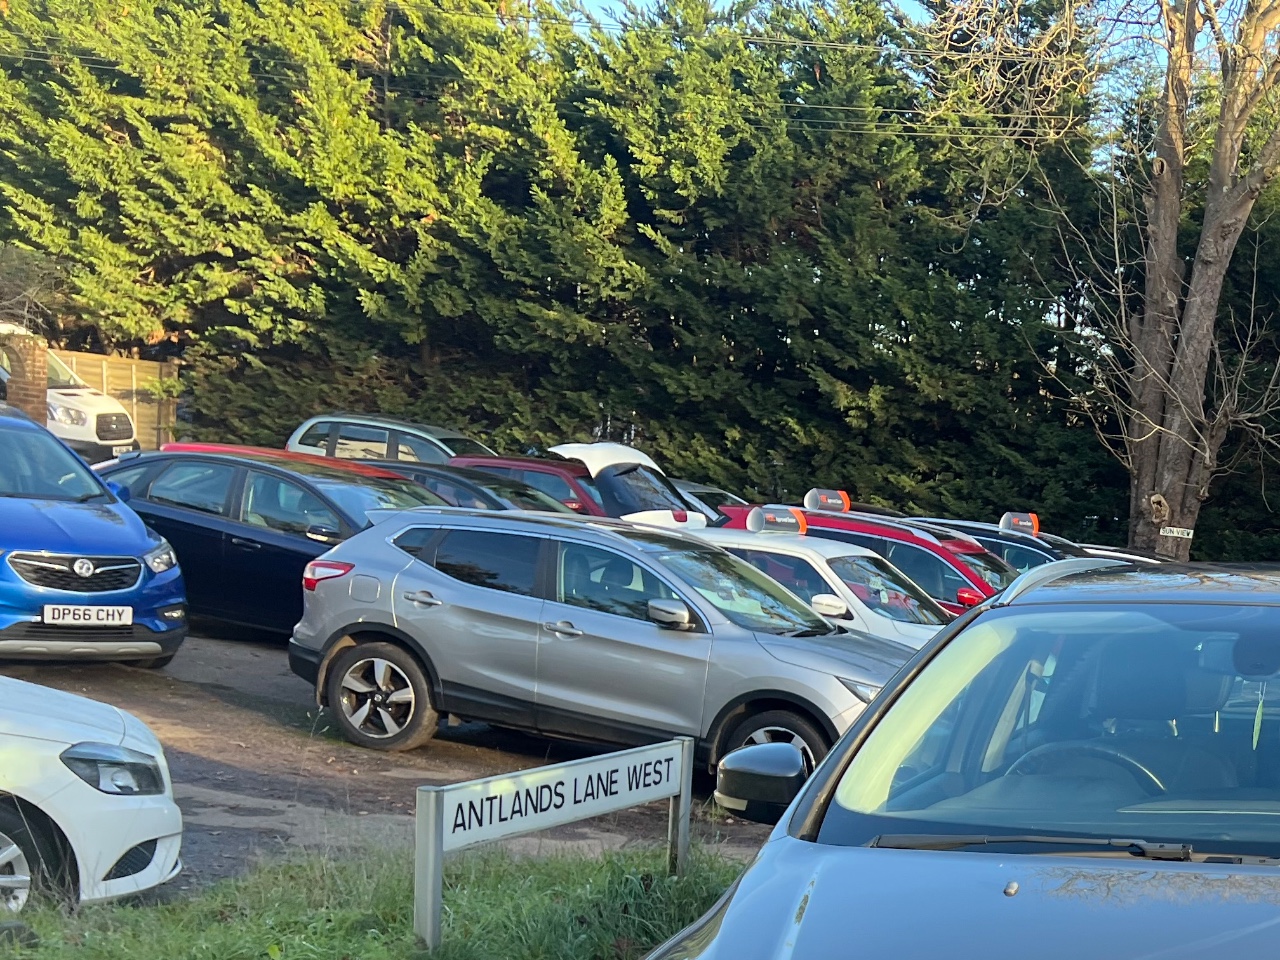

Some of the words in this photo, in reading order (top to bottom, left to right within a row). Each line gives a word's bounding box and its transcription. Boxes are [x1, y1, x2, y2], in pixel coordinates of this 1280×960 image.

[51, 607, 92, 621] DP66
[96, 608, 125, 622] CHY
[451, 780, 565, 834] ANTLANDS
[573, 768, 619, 805] LANE
[627, 757, 674, 792] WEST
